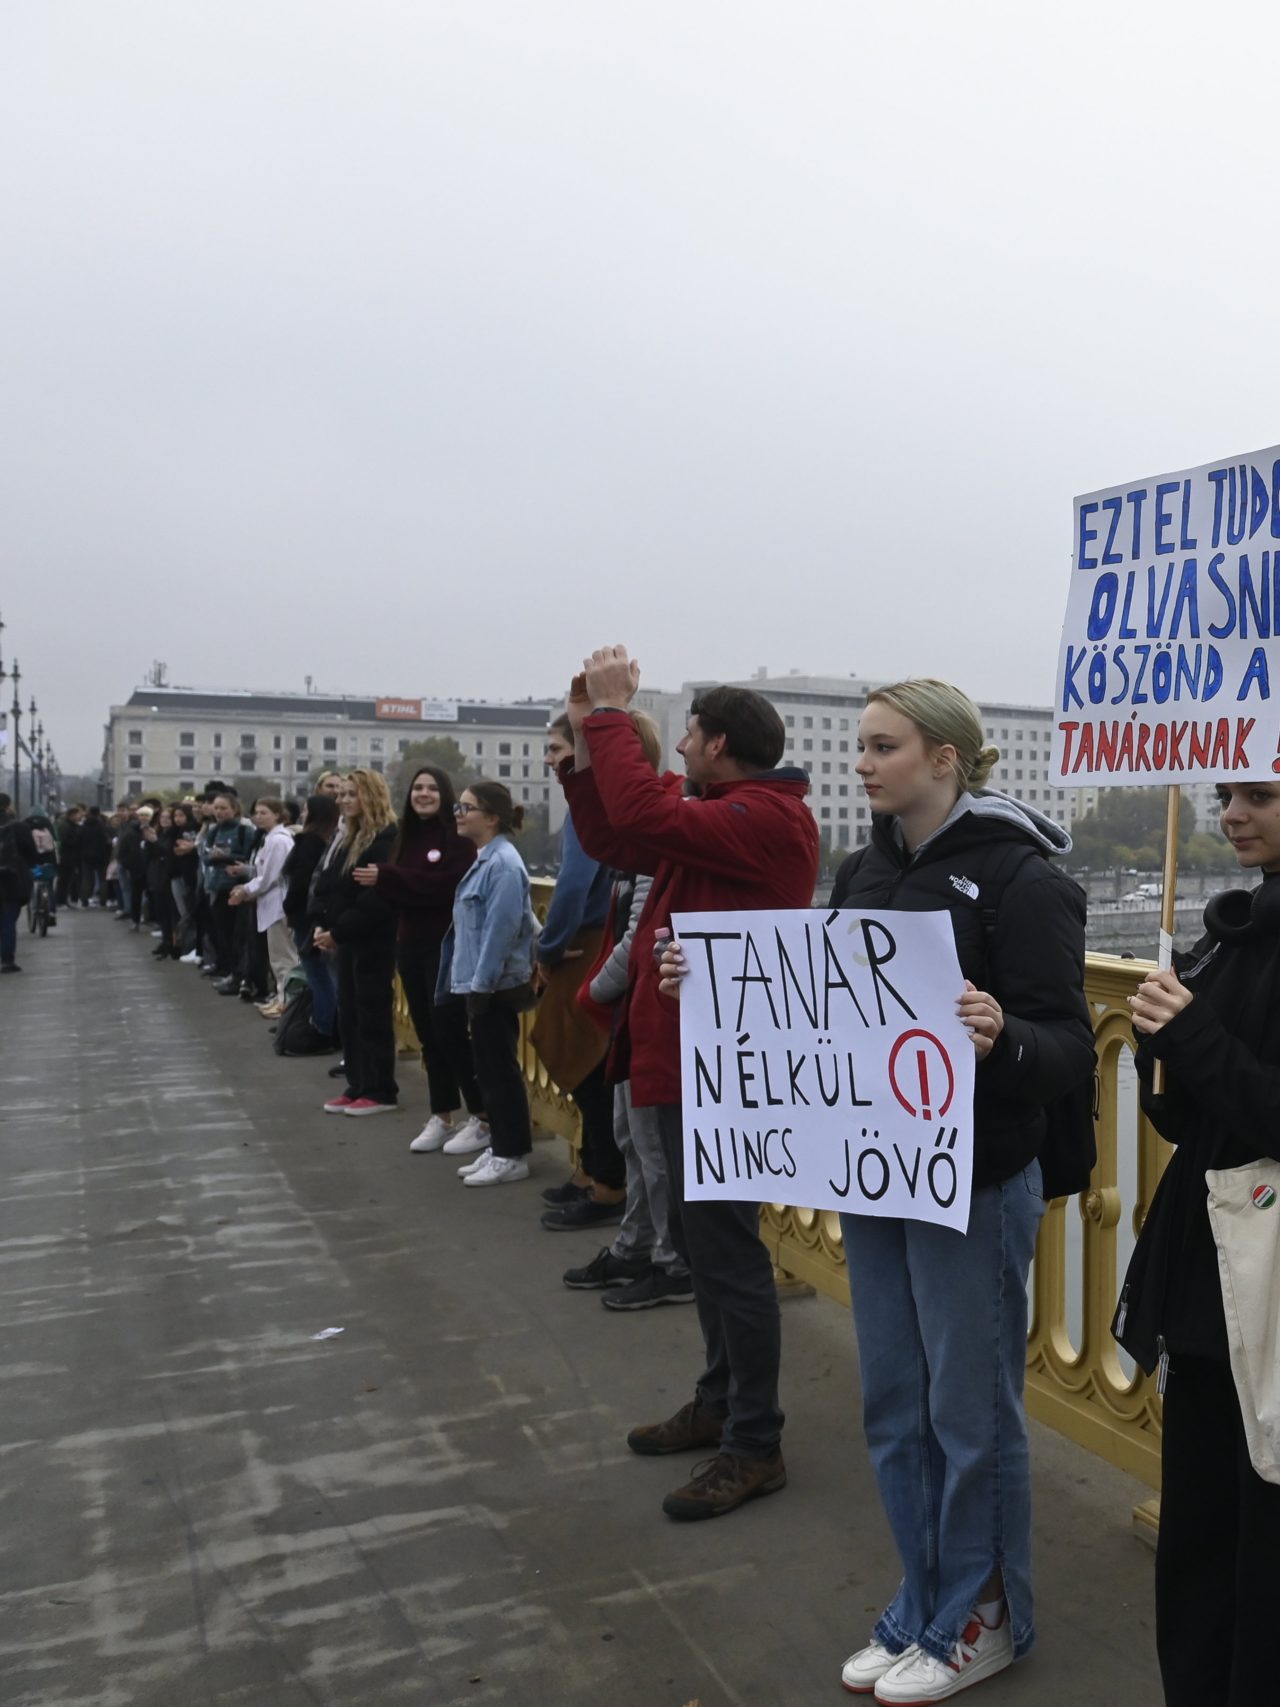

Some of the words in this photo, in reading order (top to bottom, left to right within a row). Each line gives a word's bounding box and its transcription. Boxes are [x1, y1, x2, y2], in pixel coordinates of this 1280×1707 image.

[1078, 489, 1147, 569] EZT
[1155, 479, 1198, 555] EL
[1063, 642, 1224, 712] KÖSZÖND
[1237, 647, 1270, 700] A
[1059, 711, 1256, 776] TANÁROKNAK
[948, 875, 970, 891] NORTH
[952, 882, 968, 895] FACE
[678, 909, 918, 1032] TANÁR
[694, 1032, 873, 1109] NÉLKÜL
[694, 1127, 797, 1185] NINCS
[829, 1127, 958, 1209] JÖVŐ
